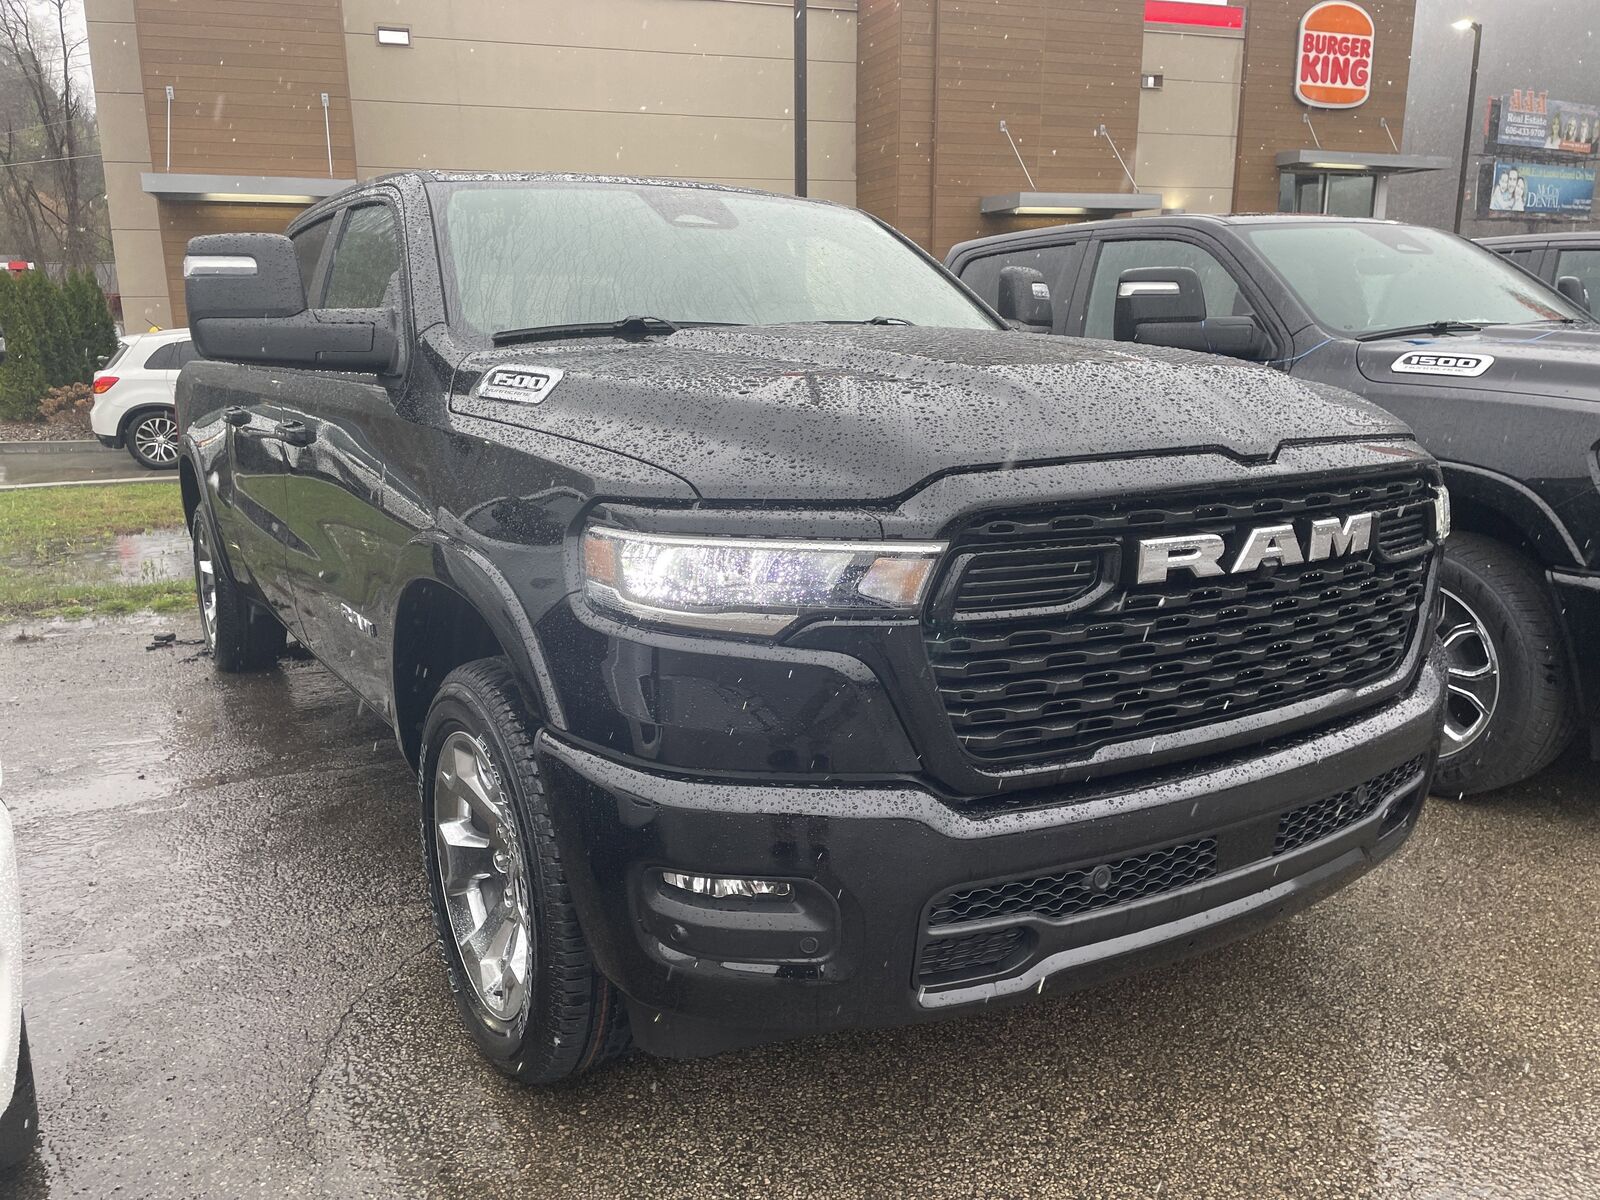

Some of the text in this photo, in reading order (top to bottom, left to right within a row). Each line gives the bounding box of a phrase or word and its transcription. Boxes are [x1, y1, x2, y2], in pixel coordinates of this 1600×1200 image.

[1303, 33, 1371, 58] BURGER
[1301, 54, 1369, 87] KING
[1507, 113, 1547, 126] Real Estate
[1505, 126, 1545, 138] 606-433-9700
[1527, 191, 1560, 210] DENTAL
[1410, 356, 1477, 368] 1500
[493, 372, 548, 389] 1500
[1137, 512, 1372, 584] RAM
